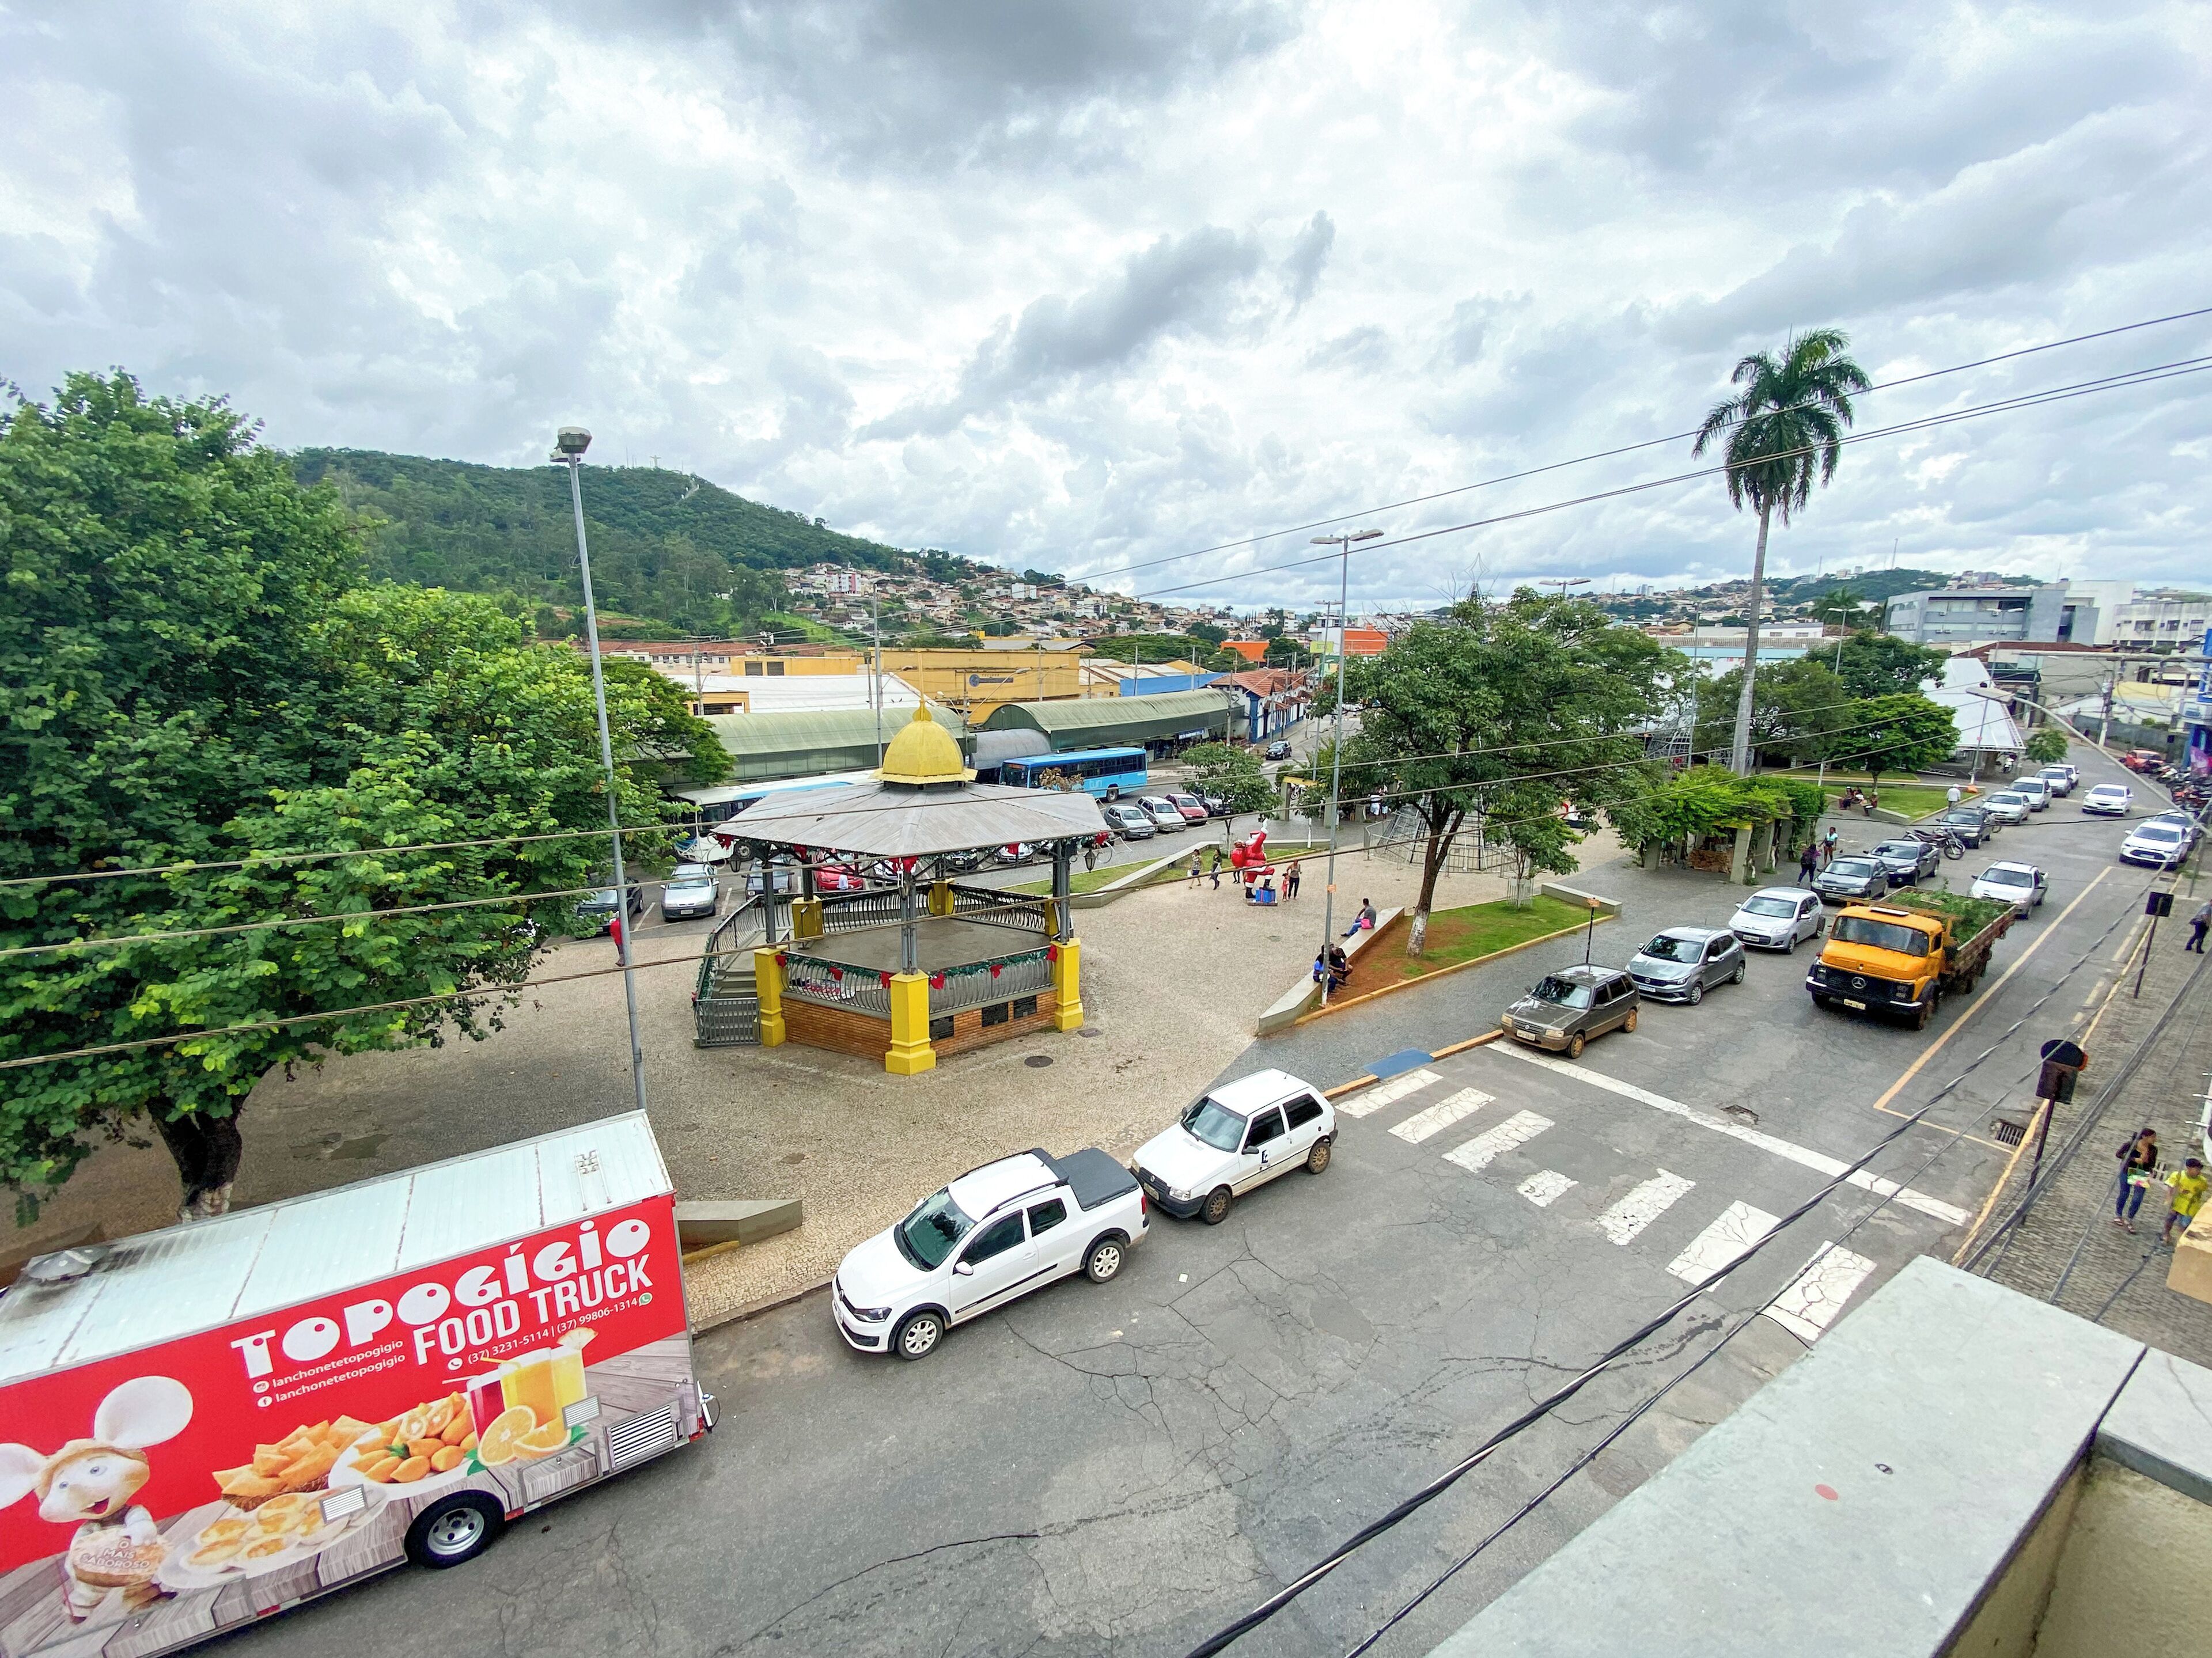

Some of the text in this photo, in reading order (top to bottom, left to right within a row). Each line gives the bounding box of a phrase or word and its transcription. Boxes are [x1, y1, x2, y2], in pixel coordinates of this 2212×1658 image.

[412, 1254, 654, 1366] FOOD TRUCK
[468, 1348, 490, 1365] (37)
[492, 1329, 549, 1356] 3231-5114
[556, 1318, 577, 1334] (37)
[578, 1297, 638, 1326] 99806-1314
[272, 1340, 404, 1388] lanchonetetopogigio
[275, 1354, 406, 1402] lanchonetetopogigio
[103, 1547, 137, 1558] MAIS
